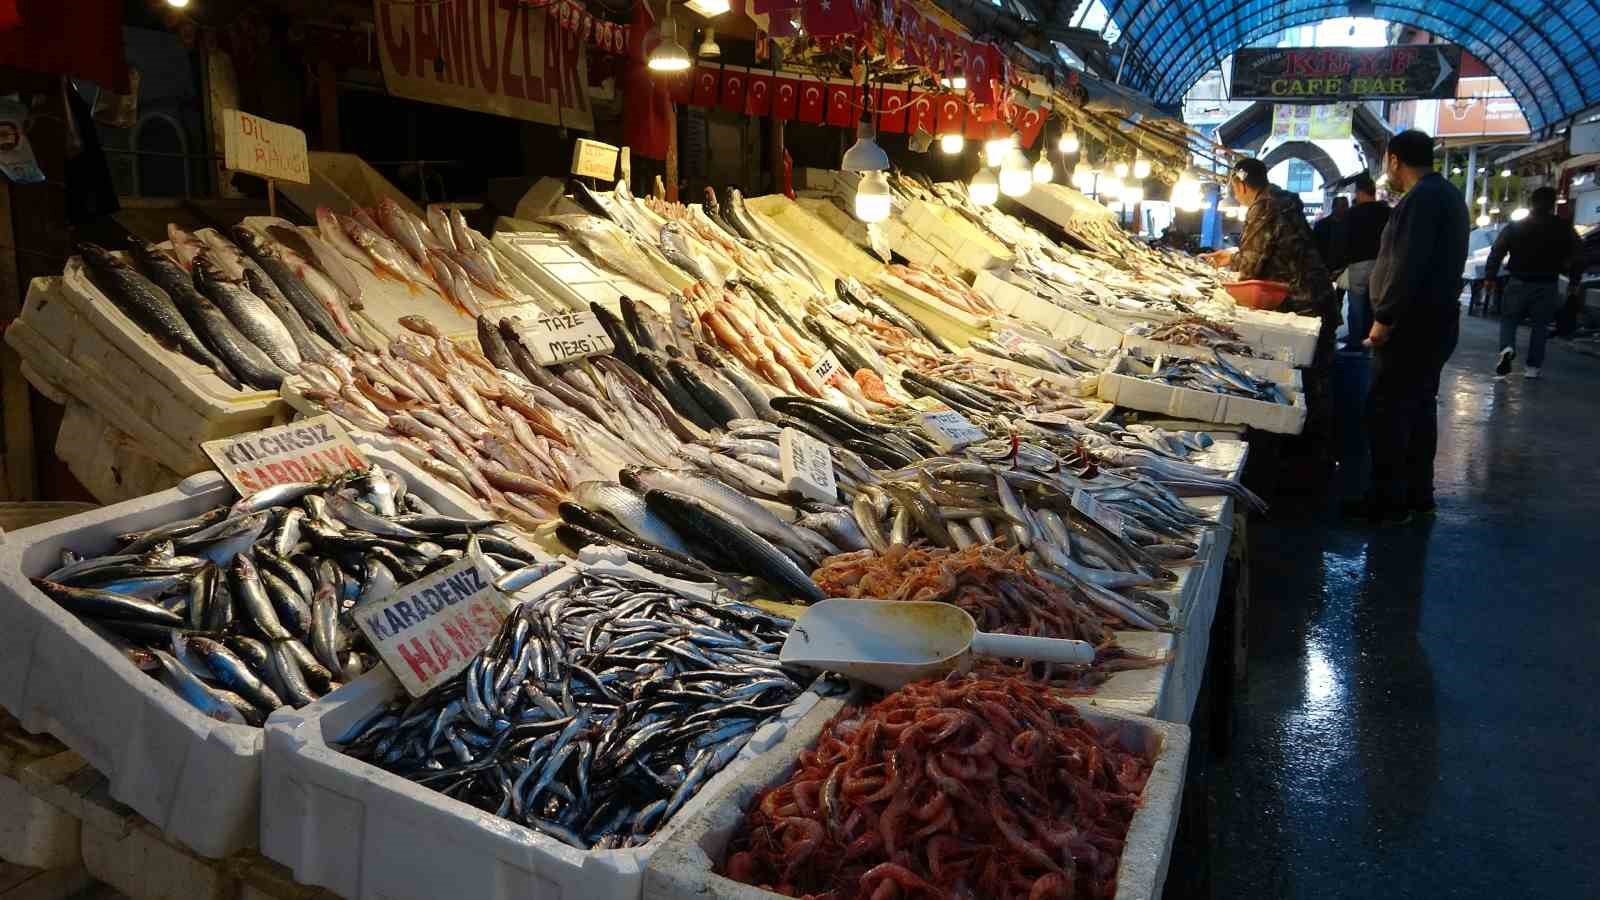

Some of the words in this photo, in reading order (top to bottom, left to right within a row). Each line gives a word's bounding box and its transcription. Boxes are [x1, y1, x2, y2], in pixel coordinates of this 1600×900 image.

[1270, 75, 1343, 95] CAFÉ
[1352, 77, 1408, 95] BAR
[538, 313, 584, 331] TAZE
[548, 333, 606, 361] MEZGİT
[815, 359, 833, 378] TAZE
[366, 565, 489, 641] KARADENİZ
